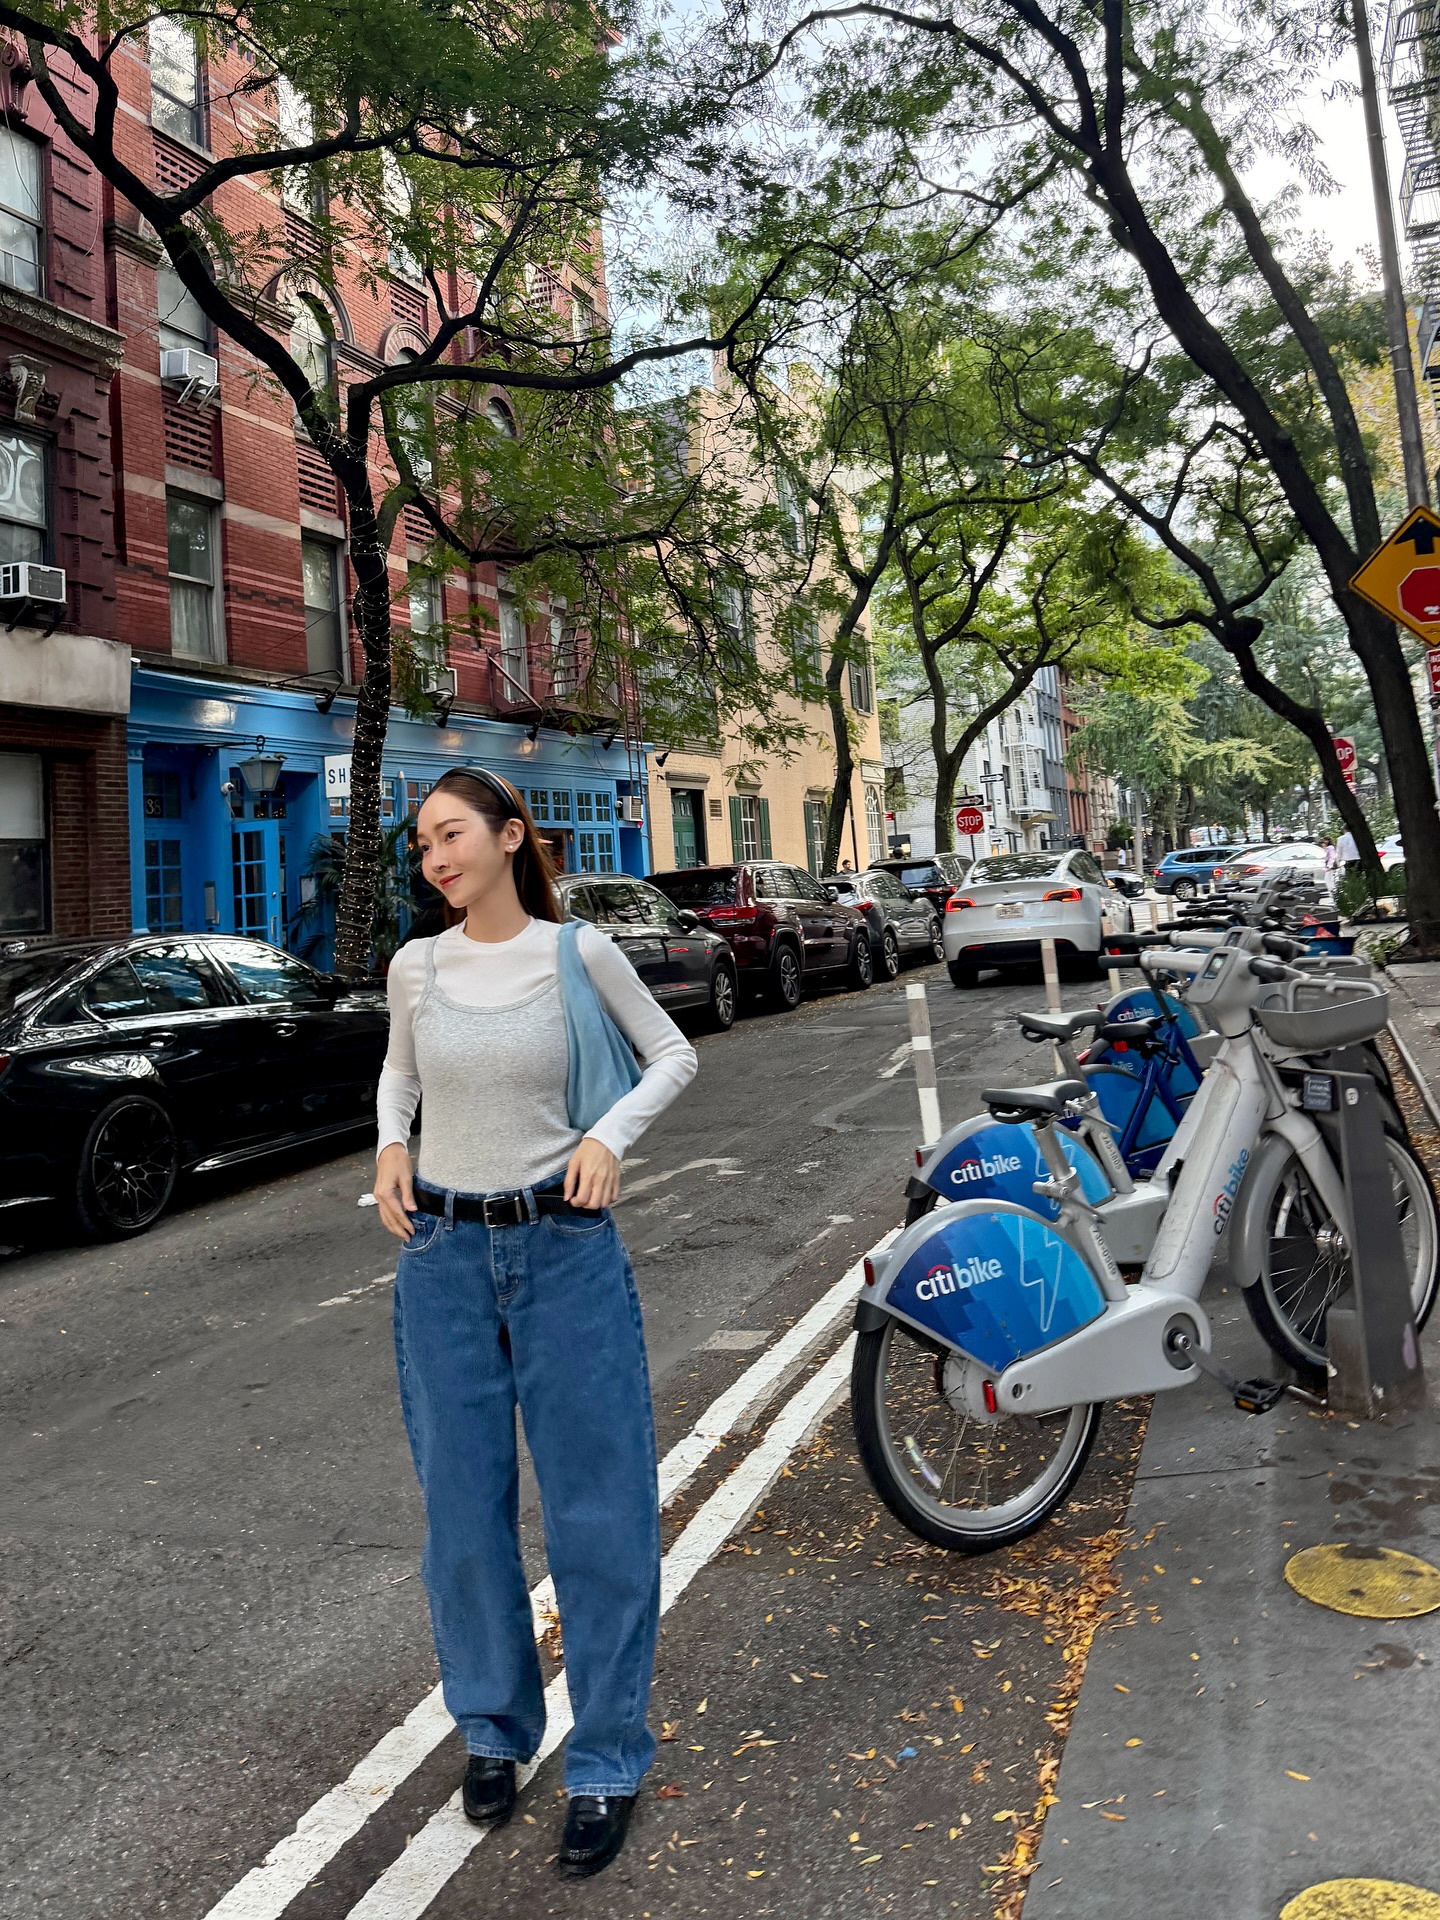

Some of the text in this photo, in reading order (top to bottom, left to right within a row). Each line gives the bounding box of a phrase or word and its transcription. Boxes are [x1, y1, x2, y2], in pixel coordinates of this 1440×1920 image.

[1335, 747, 1353, 760] OP
[957, 814, 982, 828] STOP
[950, 1154, 1022, 1185] citi bike
[1213, 1148, 1250, 1235] citi bike
[915, 1256, 1003, 1301] citi bike
